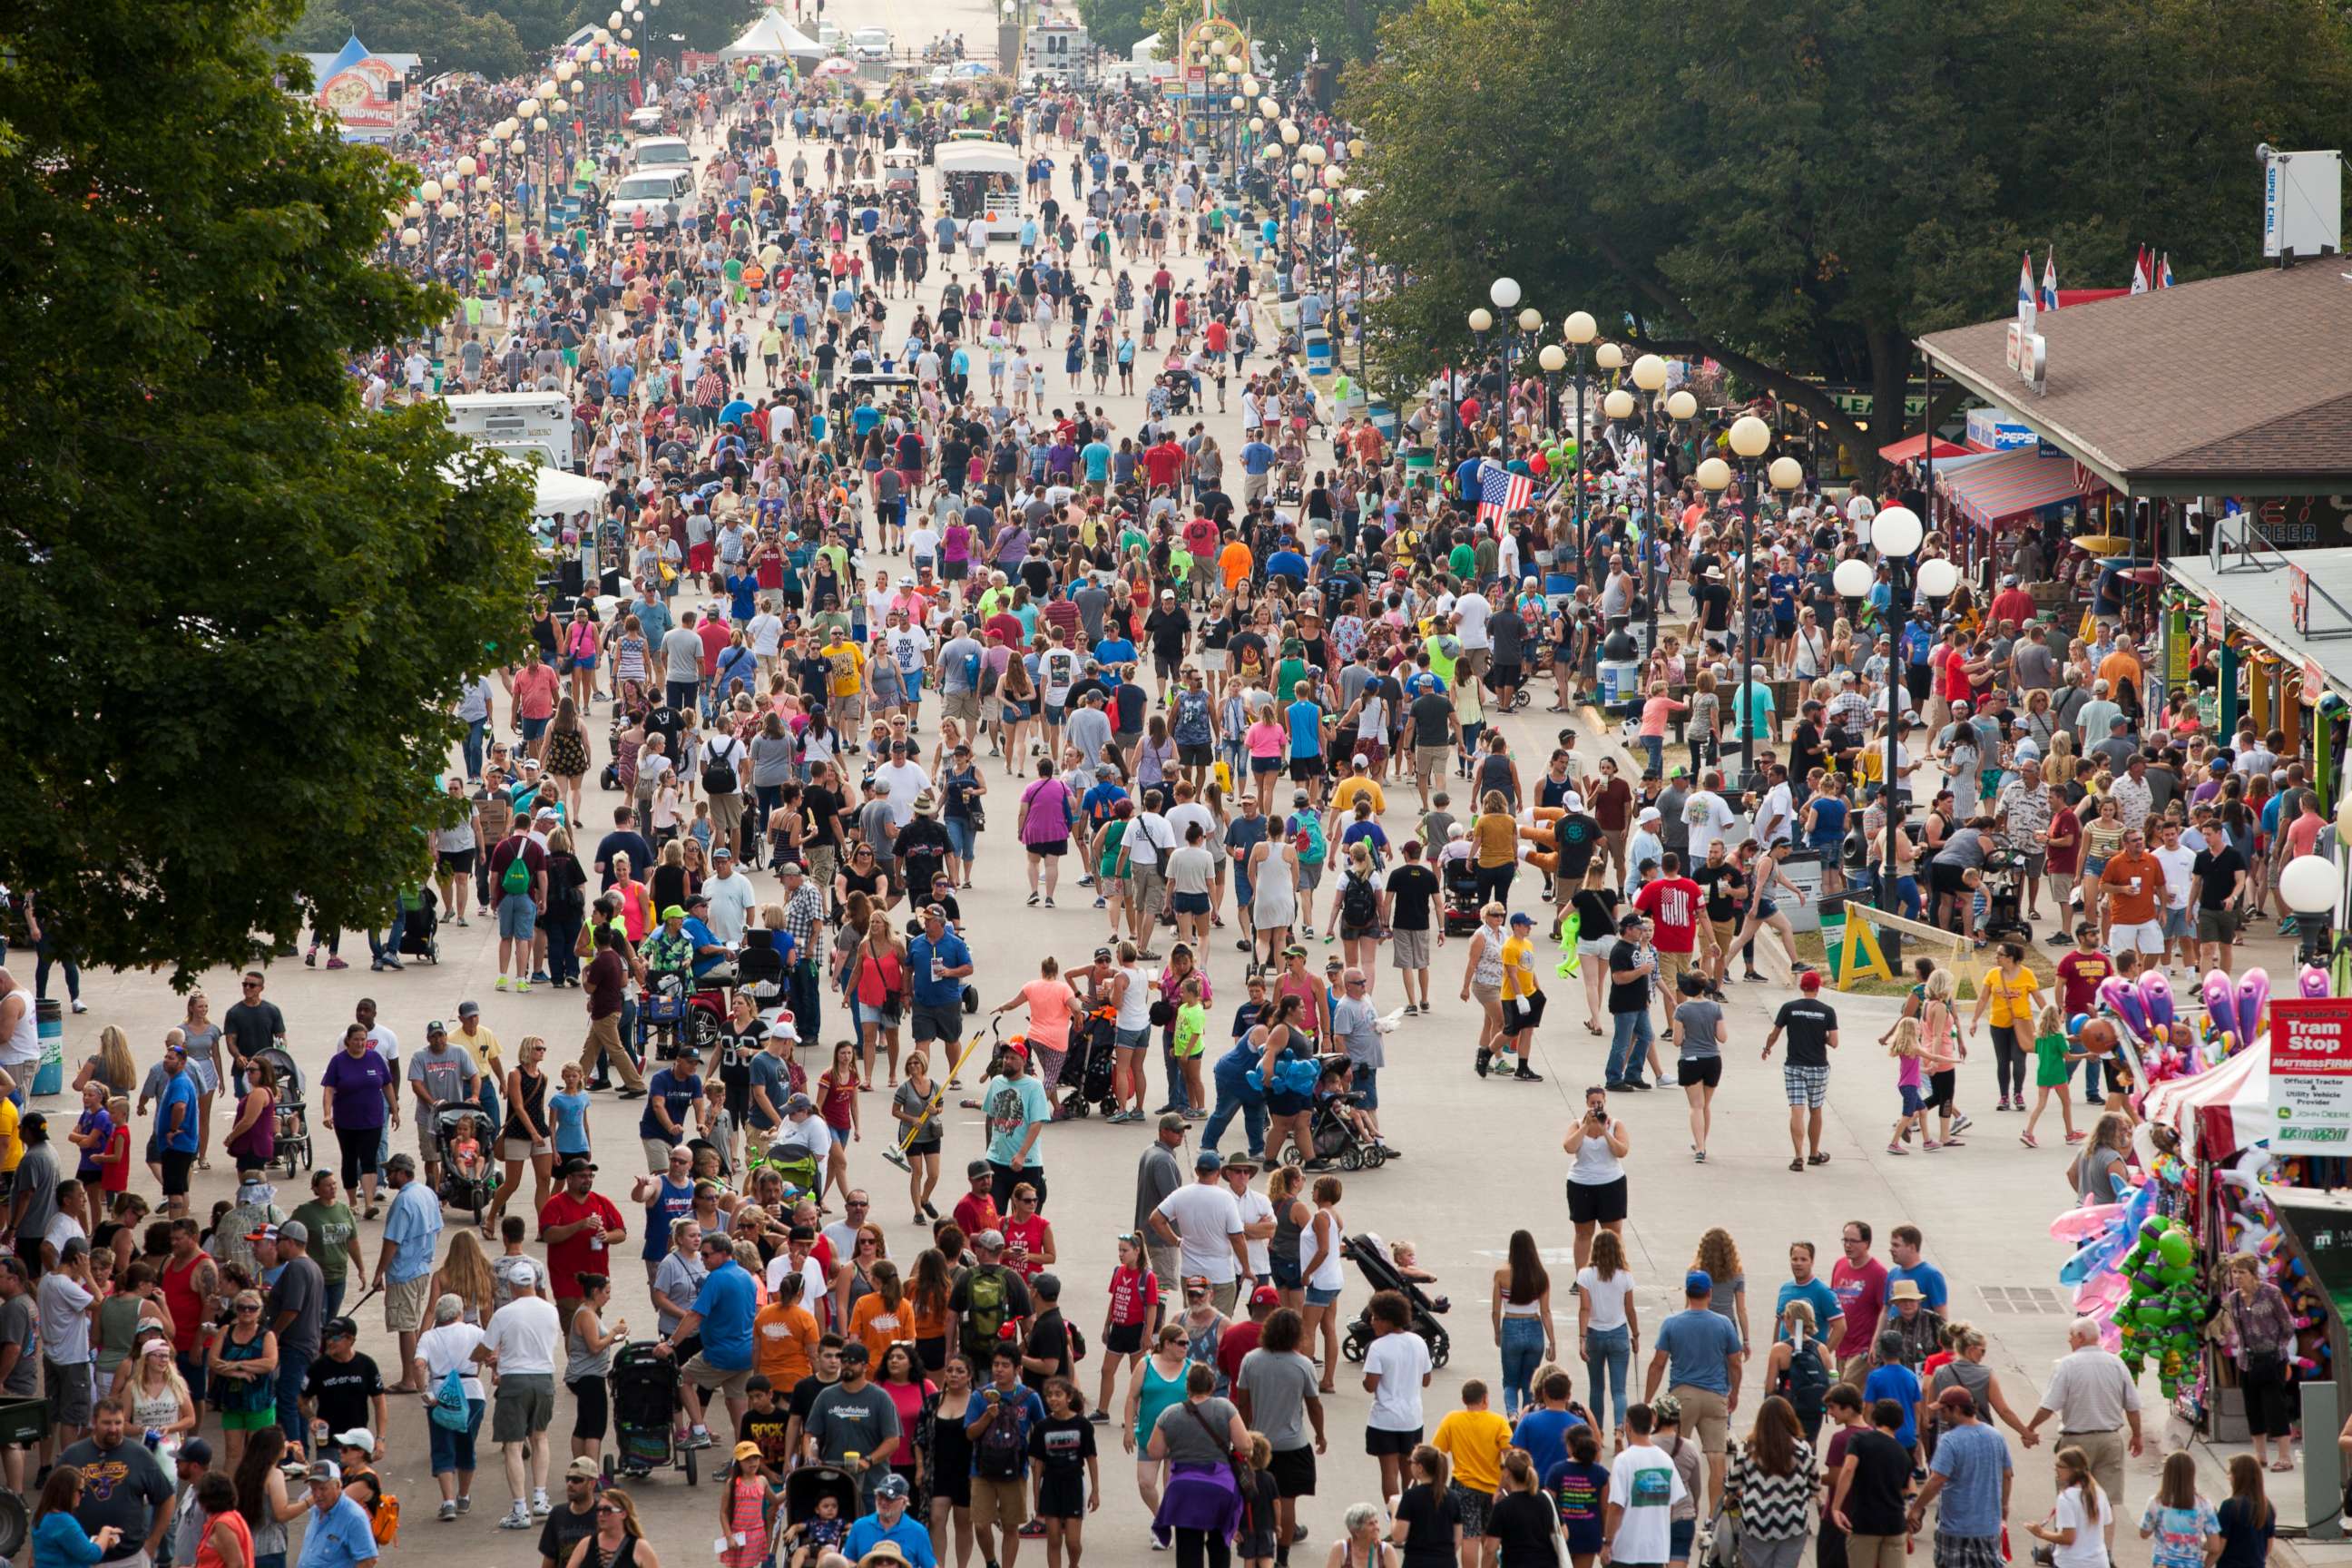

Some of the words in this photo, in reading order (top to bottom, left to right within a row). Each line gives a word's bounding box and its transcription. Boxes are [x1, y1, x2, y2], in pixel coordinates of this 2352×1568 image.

[338, 108, 393, 121] SANDWICH
[2268, 167, 2277, 203] SUPER
[2267, 207, 2275, 235] CHILL
[2002, 431, 2038, 444] PEPSI
[2257, 524, 2317, 542] BEER
[898, 638, 912, 646] YOU
[896, 645, 915, 653] CAN'T
[897, 652, 913, 662] STOP
[2288, 1020, 2341, 1034] Tram
[2288, 1036, 2340, 1053] Stop
[2284, 1077, 2314, 1085] Official
[2316, 1077, 2344, 1085] Tractor
[2286, 1091, 2309, 1099] Utility
[2321, 1110, 2350, 1118] DEERE
[1116, 1285, 1132, 1293] KEEP
[1114, 1292, 1132, 1302] CALM
[750, 1422, 784, 1437] ROCK
